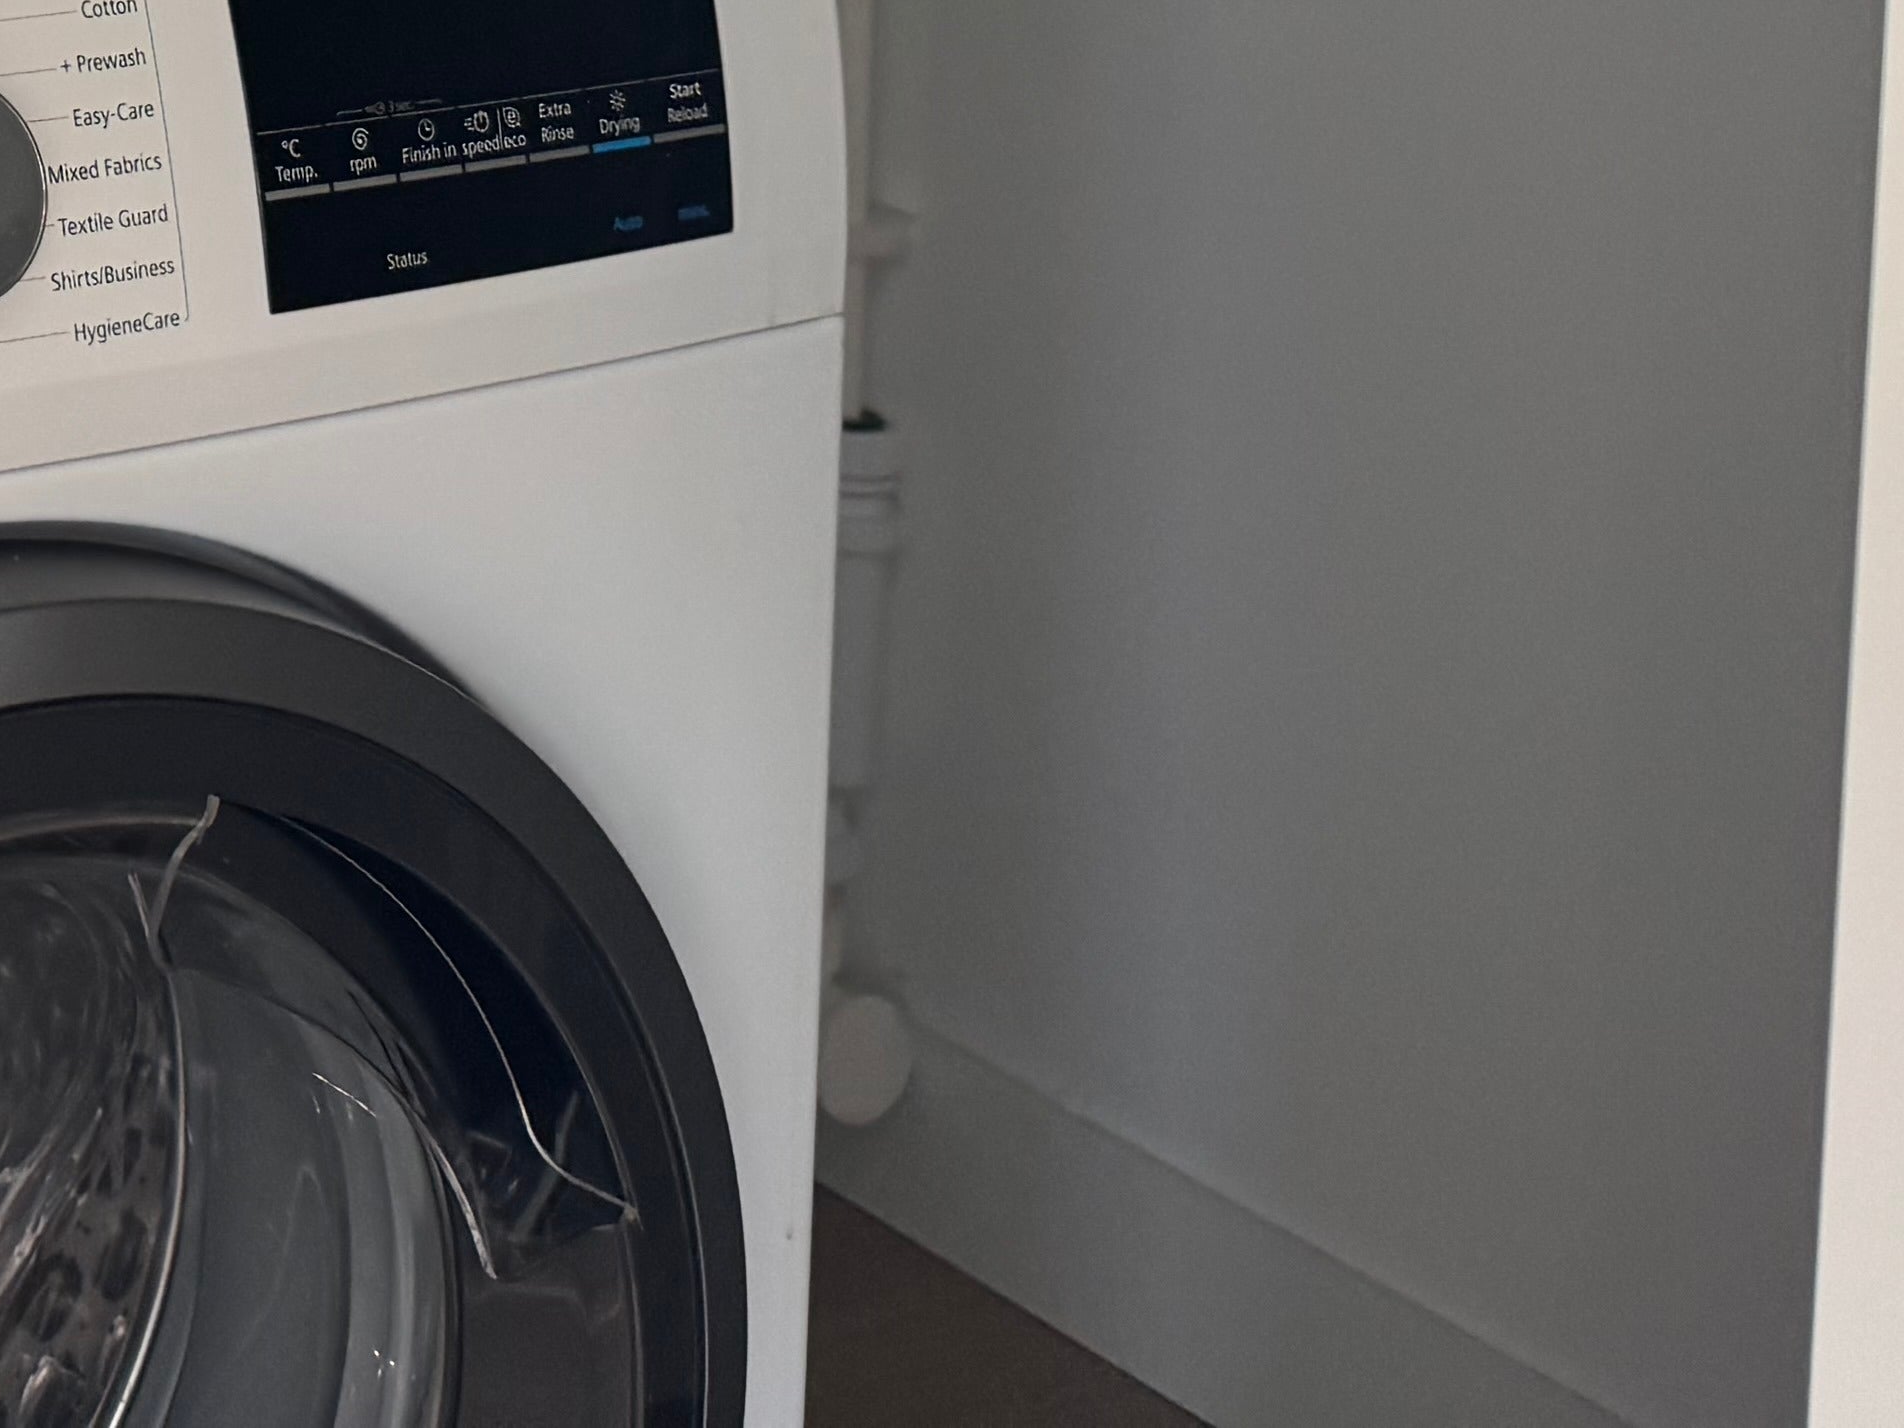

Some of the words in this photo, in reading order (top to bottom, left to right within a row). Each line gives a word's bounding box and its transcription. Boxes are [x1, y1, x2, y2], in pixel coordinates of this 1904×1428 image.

[76, 48, 147, 73] Prewash
[669, 81, 702, 99] Start
[73, 102, 154, 129] Easy-Care
[539, 102, 572, 119] Extra
[541, 126, 575, 143] Rinse
[599, 116, 641, 136] Drying
[402, 144, 441, 164] Finish
[443, 142, 457, 158] in
[462, 135, 500, 159] speed
[504, 134, 527, 149] eco
[48, 163, 100, 185] Mixed
[104, 153, 162, 178] Fabrics
[275, 165, 318, 183] Temp.
[350, 156, 377, 175] rpm
[58, 212, 114, 238] Textile
[118, 204, 170, 228] Guard
[386, 250, 428, 271] Status
[50, 258, 176, 292] Shirts/Business
[73, 309, 180, 346] HygieneCare
